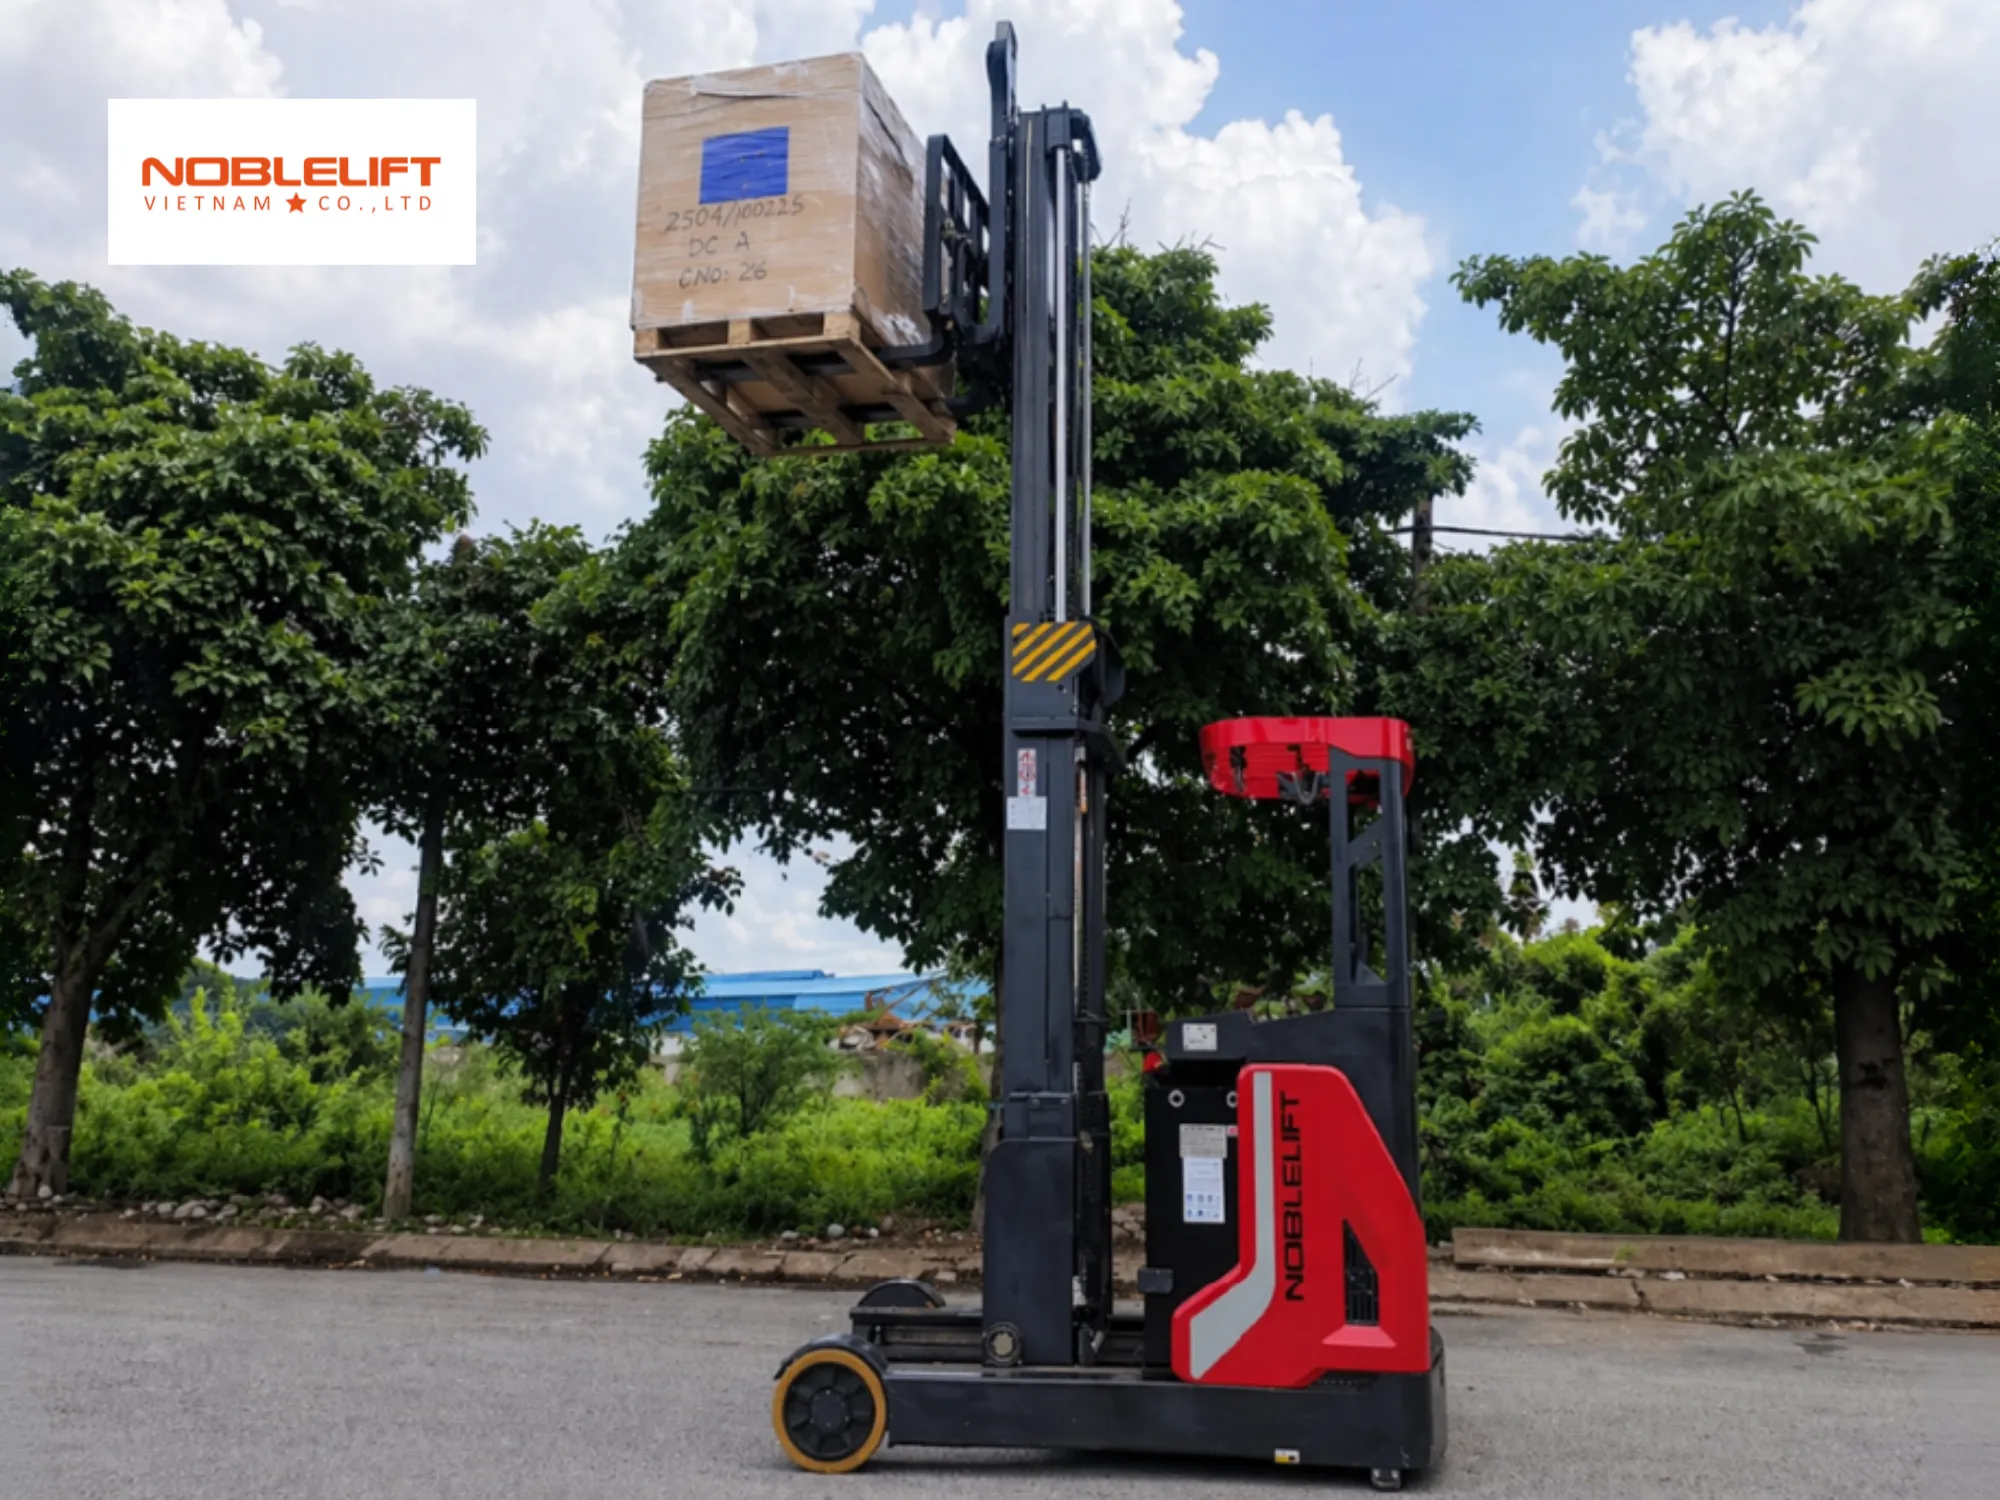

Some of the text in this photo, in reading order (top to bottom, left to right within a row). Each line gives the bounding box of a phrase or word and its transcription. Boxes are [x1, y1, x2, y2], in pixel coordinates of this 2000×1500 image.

[688, 230, 750, 258] DC A
[738, 260, 768, 283] 26
[1280, 1090, 1305, 1302] NOBLELIFT
